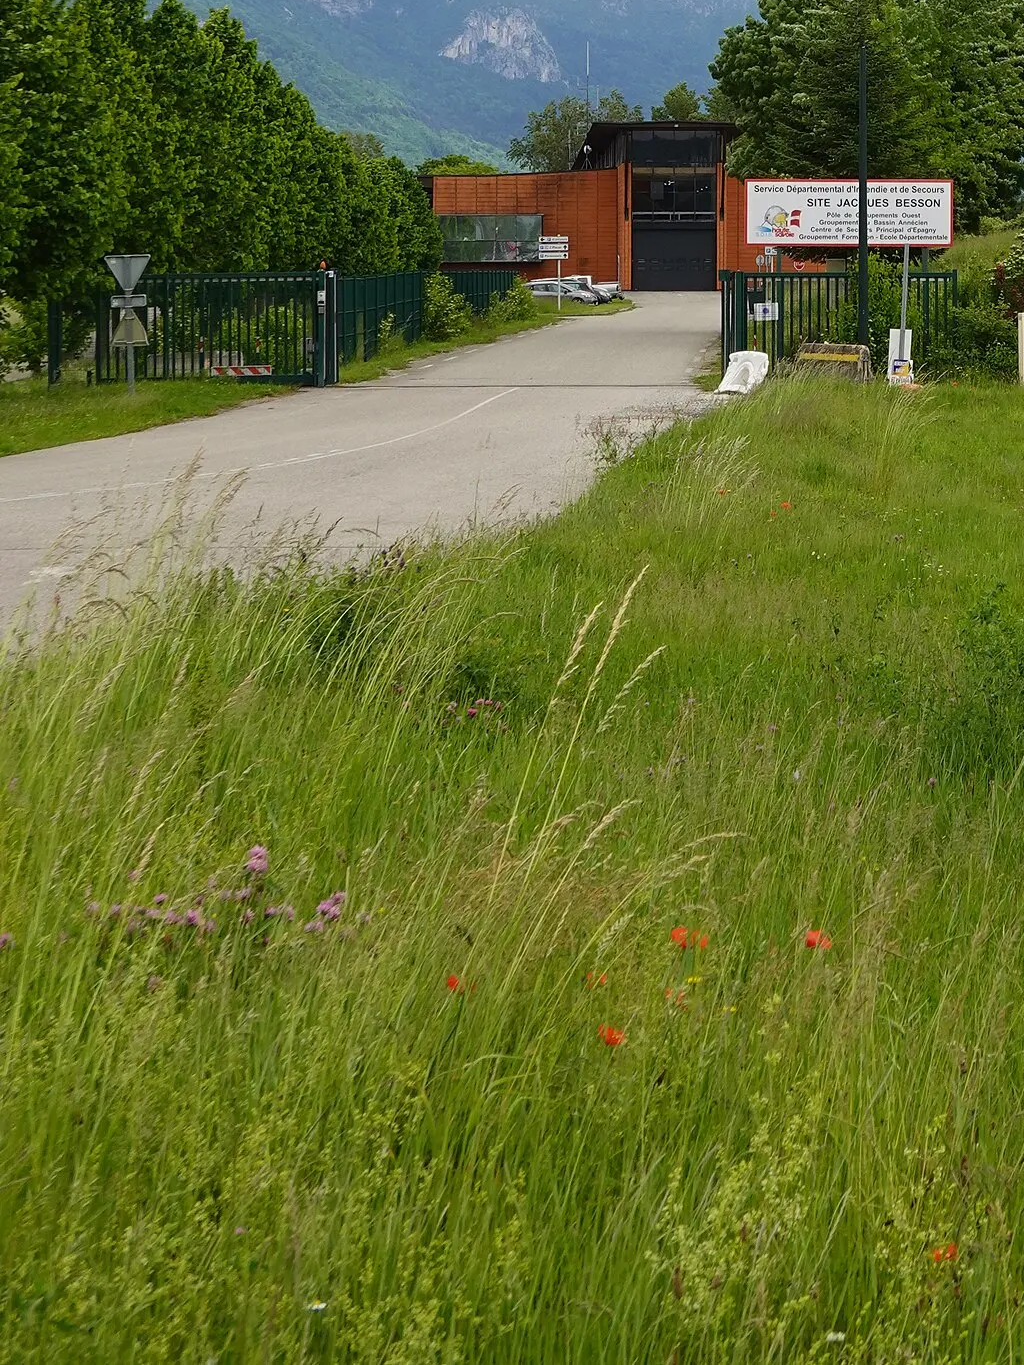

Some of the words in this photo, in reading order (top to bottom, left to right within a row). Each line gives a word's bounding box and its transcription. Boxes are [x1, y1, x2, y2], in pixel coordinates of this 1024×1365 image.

[754, 185, 784, 193] Service
[786, 184, 844, 194] Départemental
[846, 185, 888, 193] d'Inendie
[806, 198, 830, 207] SITE
[836, 198, 889, 207] JACUES
[896, 198, 941, 207] BESSON
